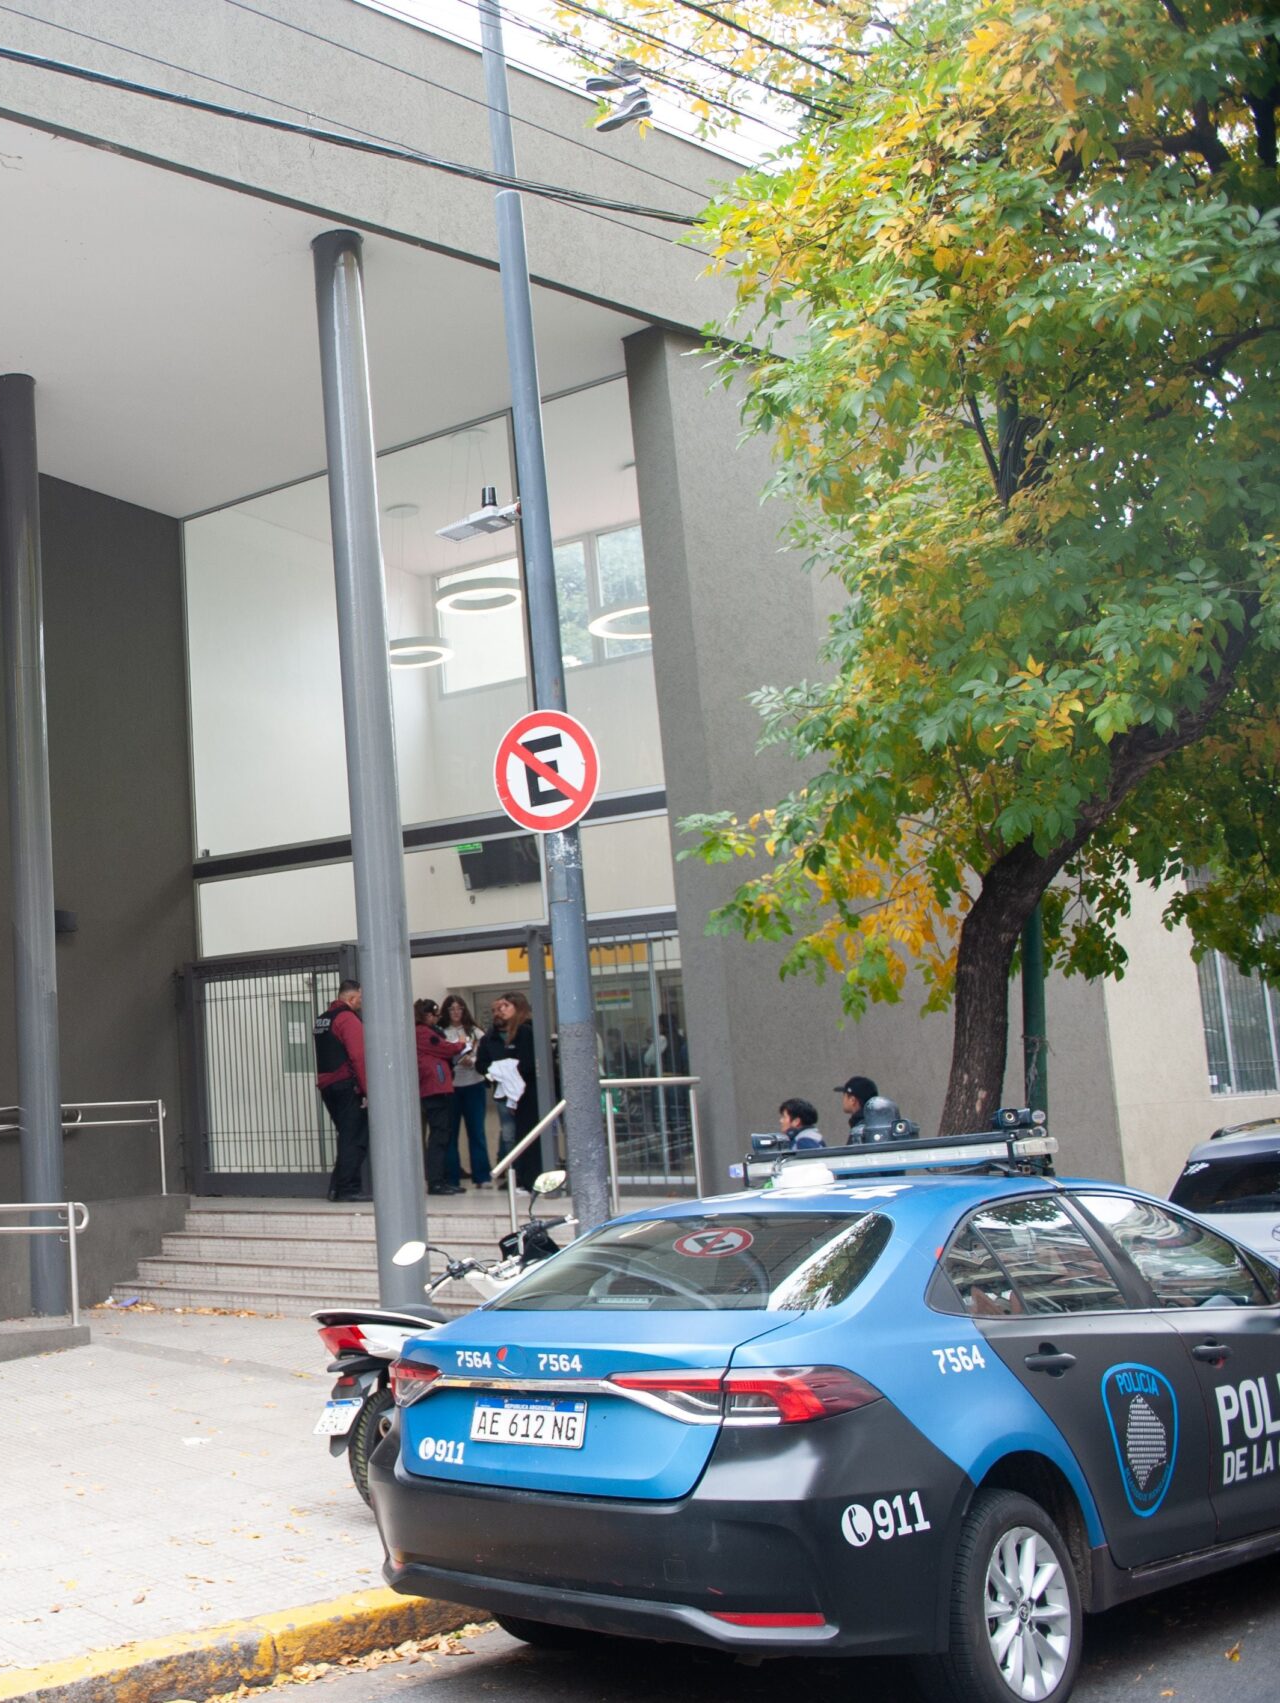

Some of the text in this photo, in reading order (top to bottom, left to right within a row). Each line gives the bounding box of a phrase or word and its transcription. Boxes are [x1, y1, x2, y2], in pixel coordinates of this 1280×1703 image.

[455, 1350, 583, 1373] 7564 7564
[931, 1345, 986, 1375] 7564
[1115, 1372, 1160, 1397] POLICIA
[1214, 1372, 1280, 1447] POL
[477, 1411, 578, 1441] AE 612 NG
[434, 1439, 466, 1465] 911
[1222, 1440, 1275, 1486] DE LA
[872, 1491, 931, 1540] 911
